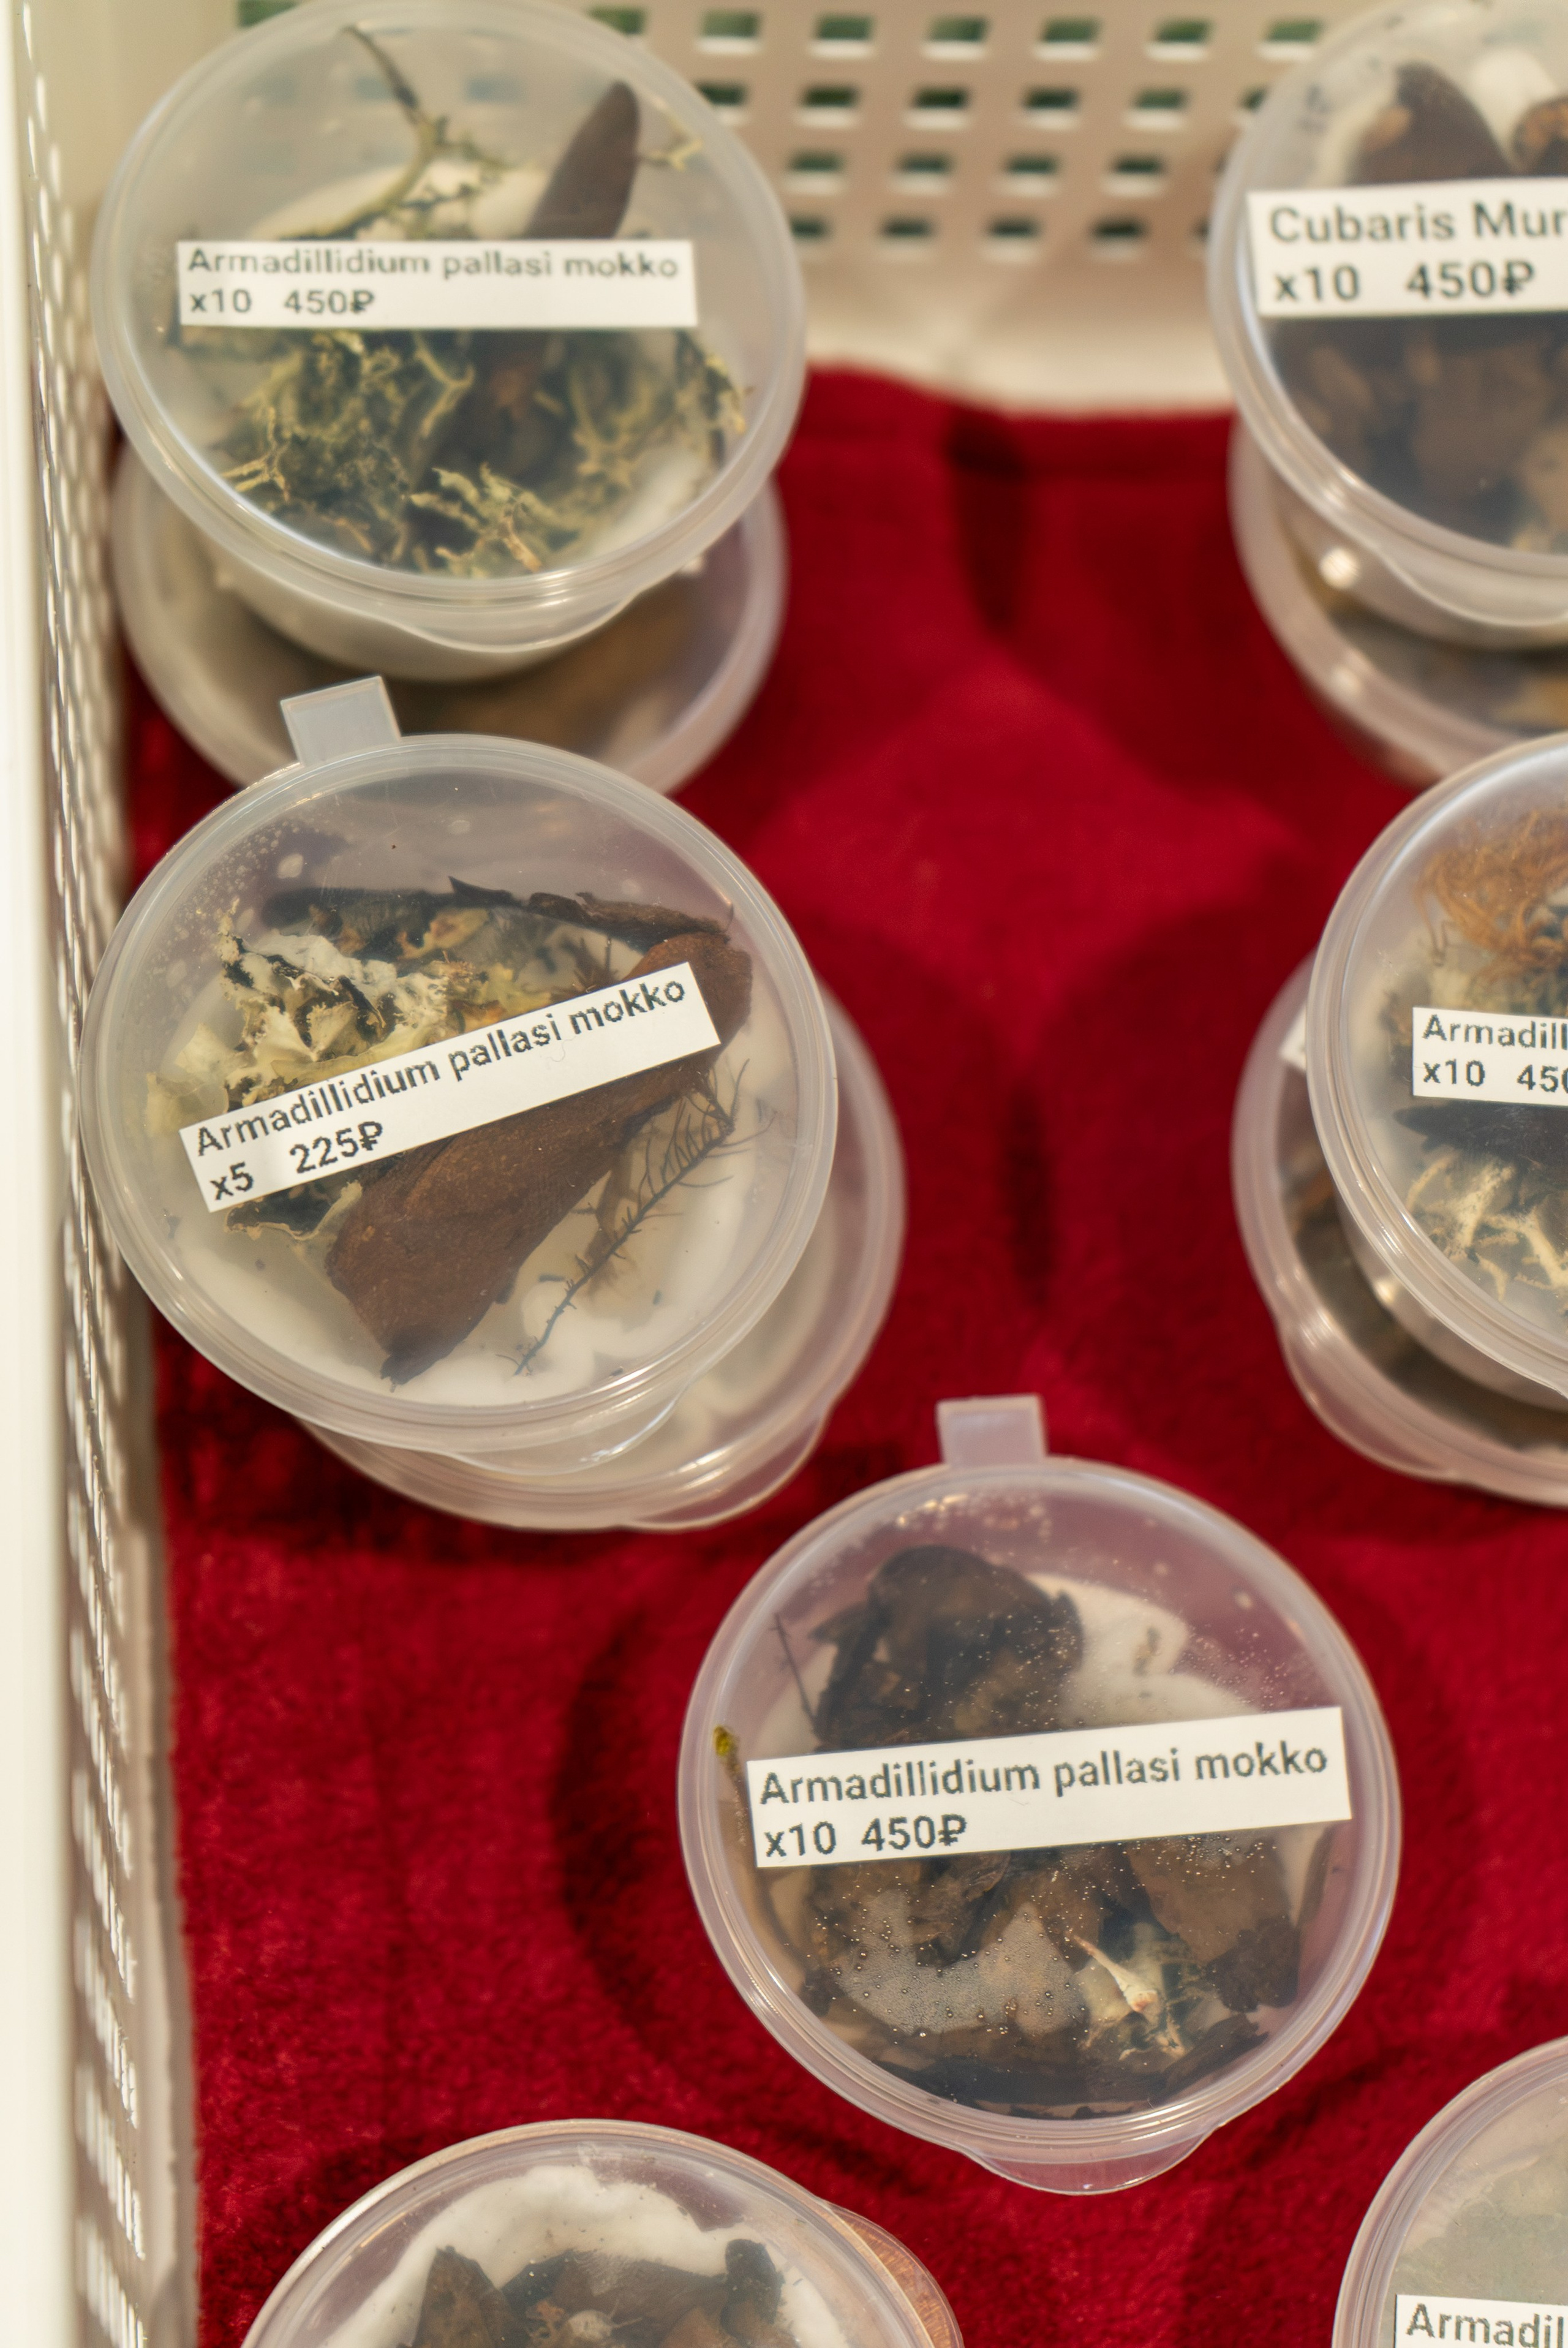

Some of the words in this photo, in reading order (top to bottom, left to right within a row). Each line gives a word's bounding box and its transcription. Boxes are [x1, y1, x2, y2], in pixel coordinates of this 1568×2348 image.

[1270, 201, 1455, 243] Cubaris
[189, 247, 429, 273] Armadillidium
[442, 250, 553, 280] pallasi
[564, 252, 679, 277] mokko
[190, 289, 252, 313] x10
[1275, 264, 1360, 302] x10
[197, 1060, 441, 1157] Armadillidium
[448, 1013, 562, 1082] pallasi
[569, 980, 686, 1035] mokko
[1423, 1059, 1485, 1087] x10
[210, 1161, 254, 1201] x5
[760, 1757, 1041, 1805] Armadillidium
[1054, 1748, 1180, 1798] pallasi
[1196, 1740, 1328, 1780] mokko
[765, 1821, 837, 1857] x10
